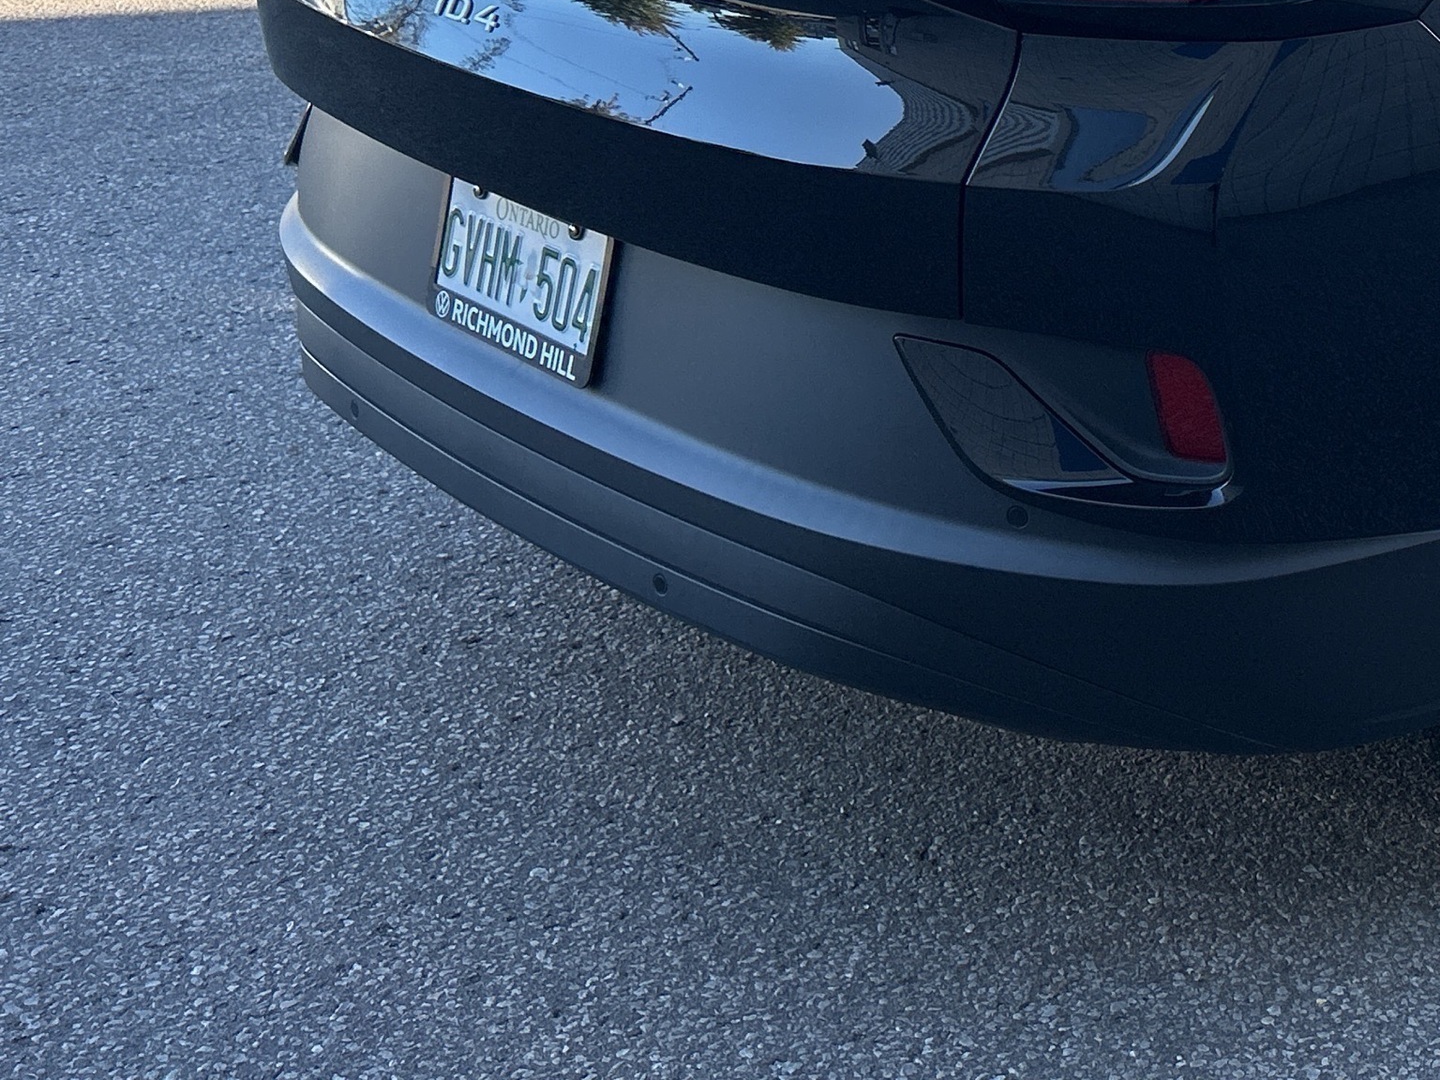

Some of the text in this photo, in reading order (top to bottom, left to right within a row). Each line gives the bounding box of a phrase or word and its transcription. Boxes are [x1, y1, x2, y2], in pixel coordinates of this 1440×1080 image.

[442, 207, 597, 344] GVHM 504
[451, 298, 538, 359] RICHMOND
[539, 341, 576, 381] HILL
